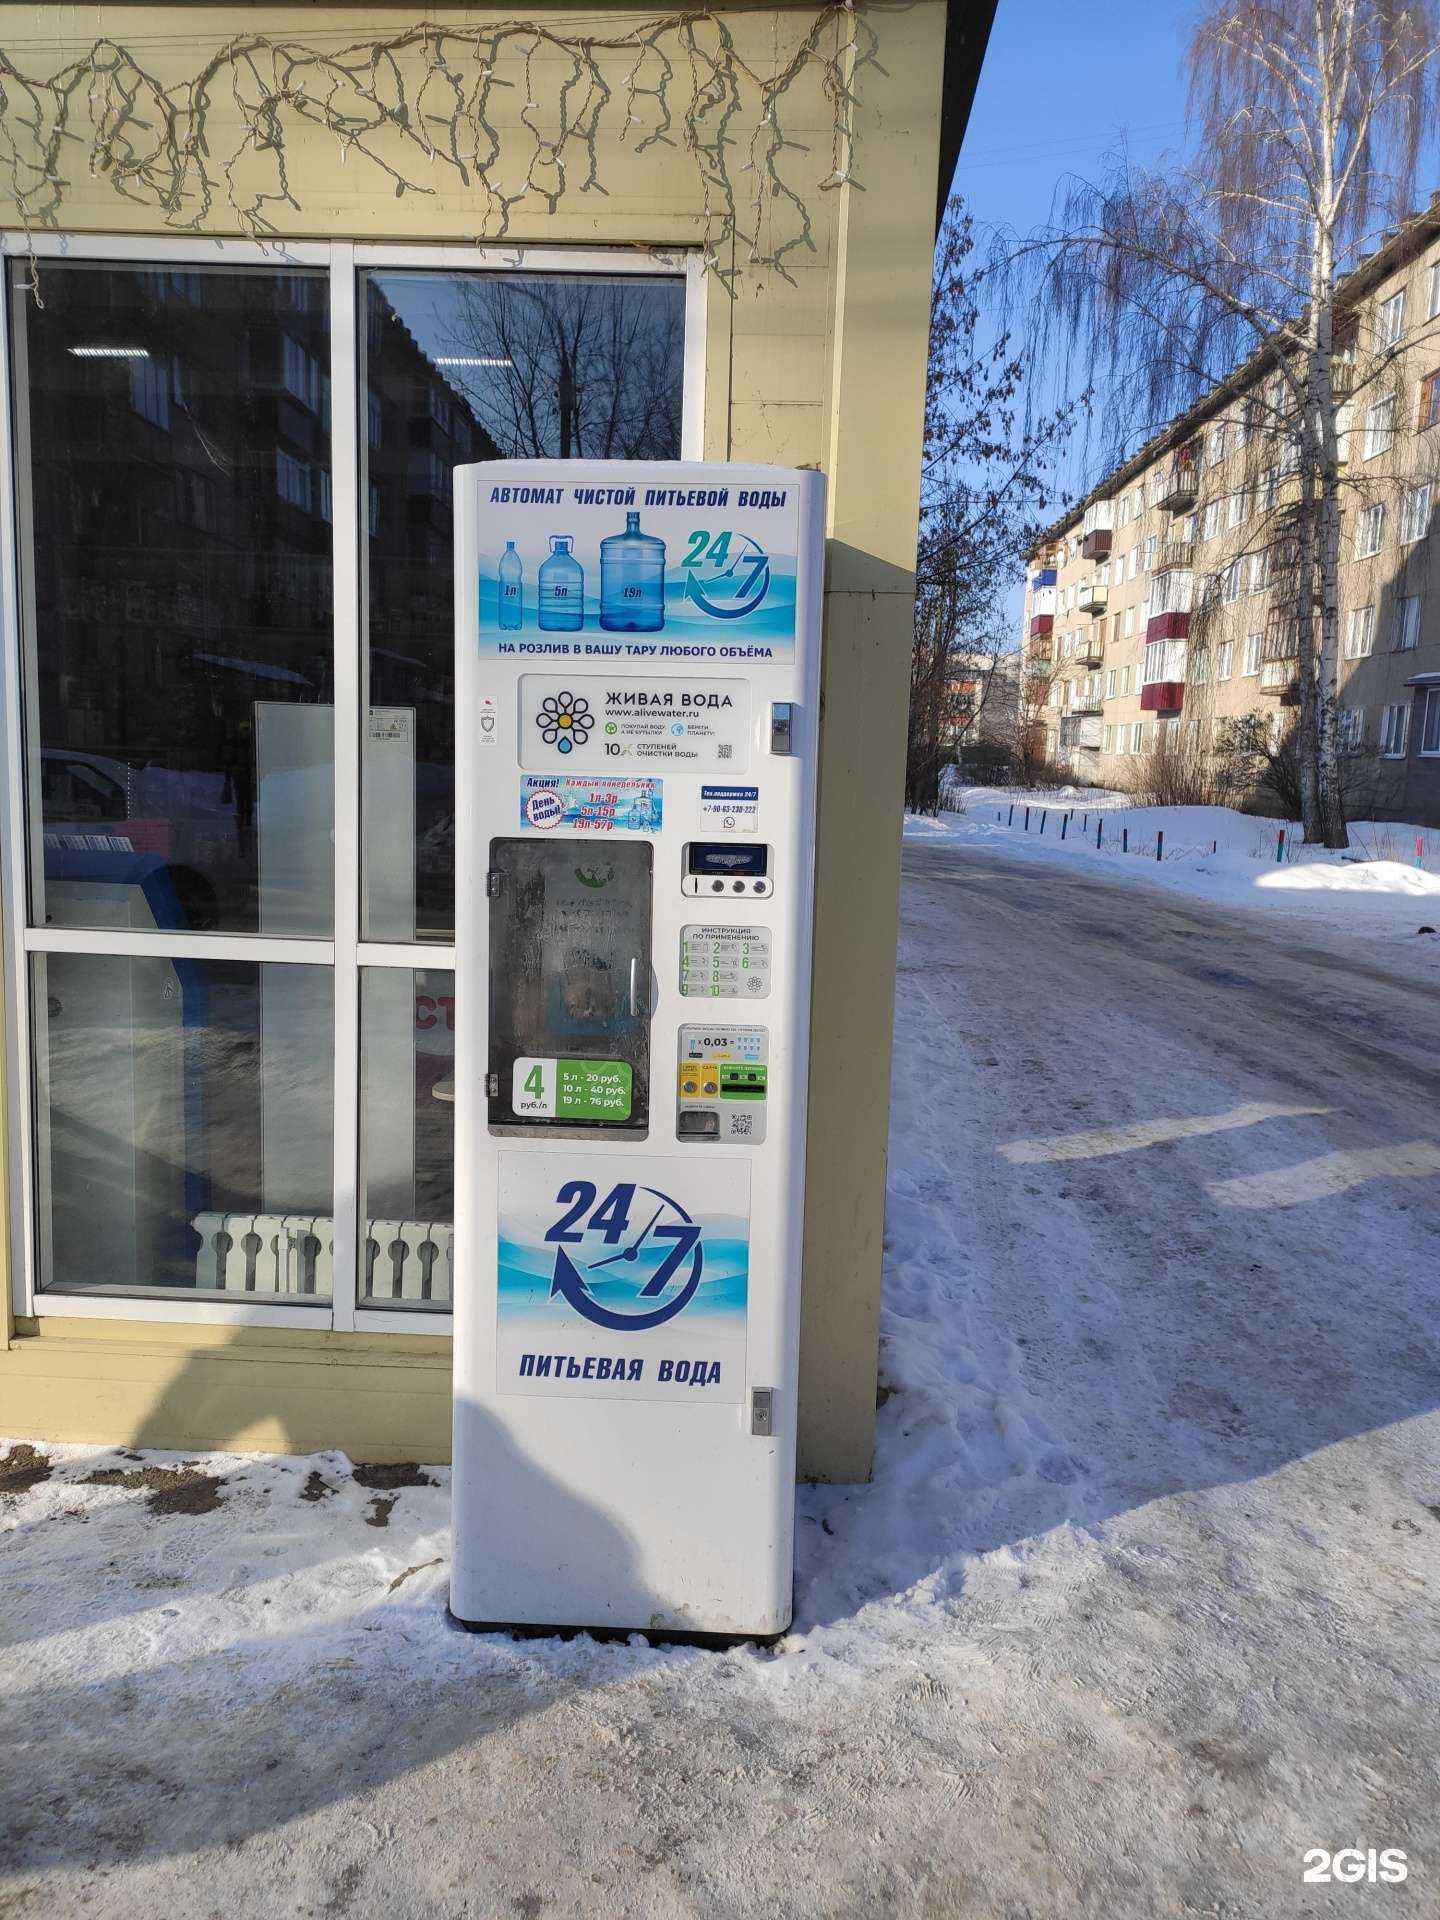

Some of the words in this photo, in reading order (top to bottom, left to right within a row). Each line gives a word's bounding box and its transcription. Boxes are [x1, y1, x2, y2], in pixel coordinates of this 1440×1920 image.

[490, 486, 564, 505] АВТОМАТ
[573, 486, 636, 506] ЧИСТОЙ
[644, 487, 729, 508] ПИТЬЕВОЙ
[738, 490, 787, 509] ВОДЫ
[681, 530, 733, 567] 24
[735, 555, 769, 599] 7
[504, 584, 517, 596] 1л
[555, 585, 569, 597] 5л
[623, 587, 643, 598] 19л
[499, 643, 515, 653] НА
[519, 643, 570, 654] РОЗЛИВ
[574, 645, 581, 654] В
[585, 644, 622, 656] ВАШУ
[626, 645, 656, 656] ТАРУ
[659, 646, 716, 657] ЛЮБОГО
[719, 645, 773, 658] ОБЪЁМА
[605, 692, 673, 706] ЖИВАЯ
[681, 693, 733, 709] ВОДА
[605, 707, 700, 718] www.alivewater.ru
[636, 750, 673, 758] ОЧИСТКИ
[674, 751, 698, 759] ВОДЫ
[526, 777, 560, 788] Акция!
[532, 796, 555, 811] День
[533, 806, 561, 822] воды!
[701, 927, 751, 935] ИНСТРУКЦИЯ
[692, 933, 704, 941] ПО
[705, 934, 760, 942] ПРИМЕНЕНИЮ
[713, 942, 720, 953] 2
[742, 943, 750, 955] 3
[682, 956, 689, 967] 4
[712, 956, 720, 968] 5
[742, 957, 749, 969] 6
[712, 971, 719, 982] 8
[703, 1037, 728, 1047] 0,03
[523, 1064, 545, 1099] 4
[563, 1073, 569, 1081] 5
[586, 1074, 598, 1082] 20
[601, 1075, 622, 1084] руб.
[590, 1086, 603, 1094] 40
[605, 1087, 626, 1095] руб.
[521, 1101, 548, 1110] руб./л
[563, 1096, 572, 1104] 19
[590, 1097, 602, 1105] 76
[604, 1098, 625, 1107] руб.
[544, 1180, 637, 1244] 24
[639, 1225, 702, 1297] 7
[519, 1354, 644, 1381] ПИТЬЕВАЯ
[657, 1359, 722, 1387] ВОДА
